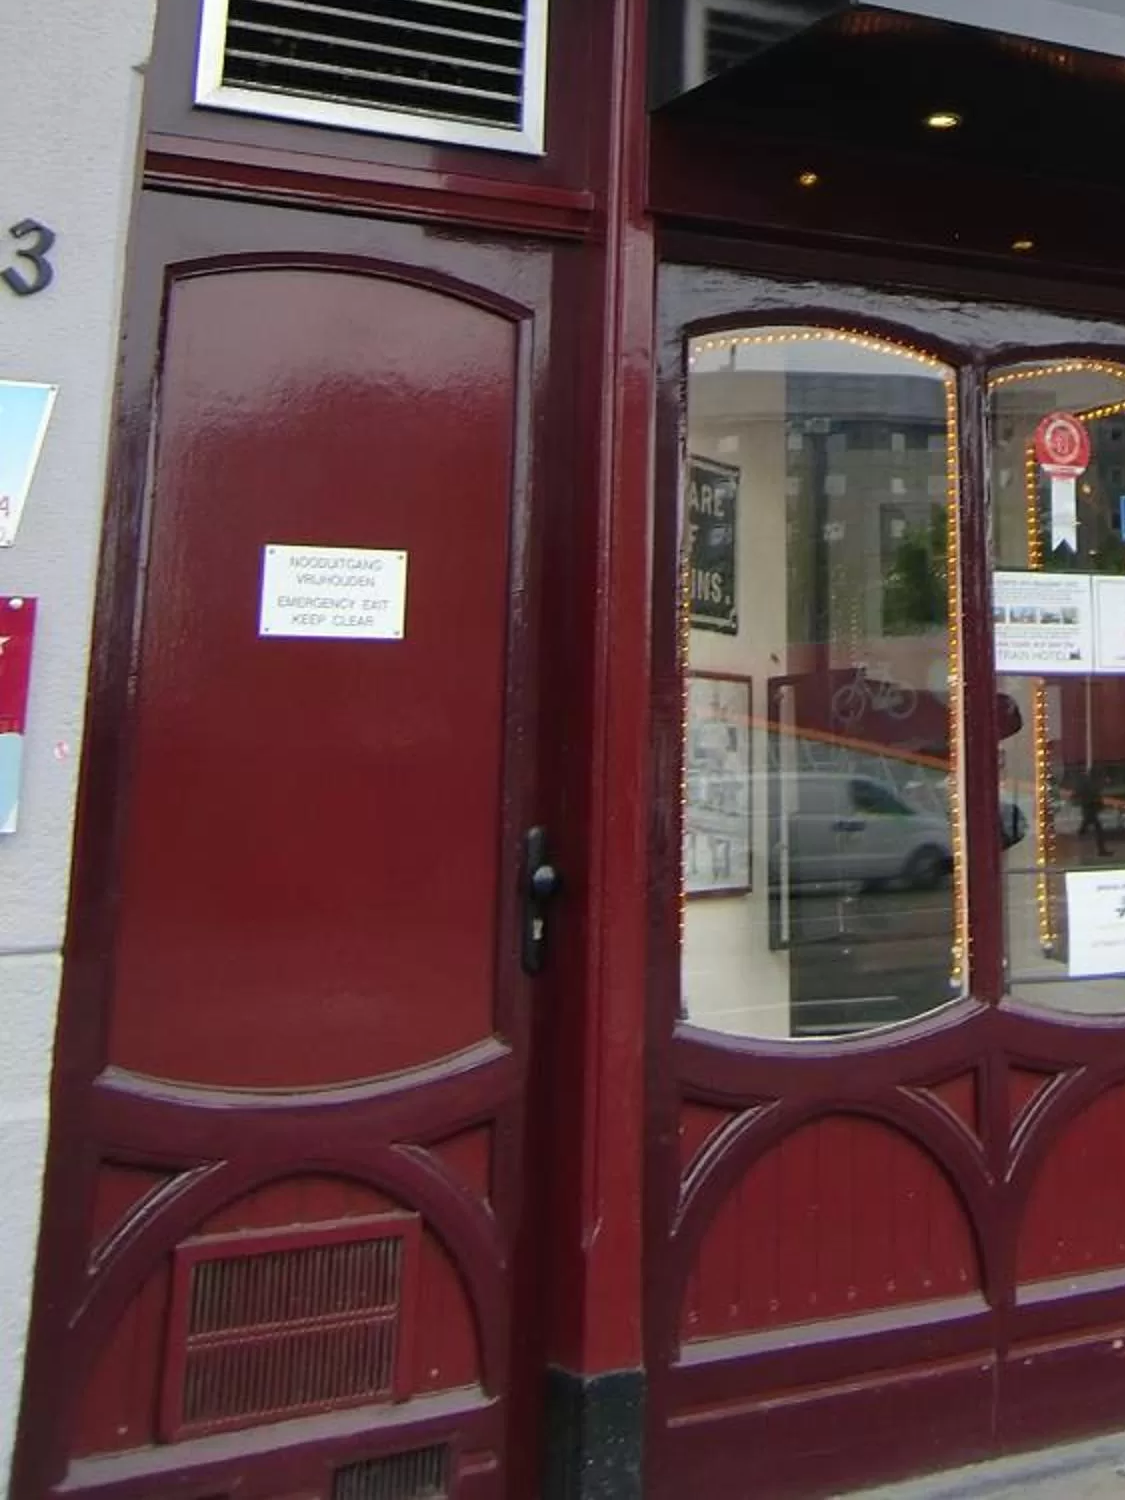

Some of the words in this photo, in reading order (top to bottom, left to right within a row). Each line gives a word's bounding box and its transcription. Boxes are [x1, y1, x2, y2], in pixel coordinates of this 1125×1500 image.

[277, 595, 355, 609] EMERGENCY
[361, 599, 390, 611] EXIT
[291, 613, 326, 626] KEEP
